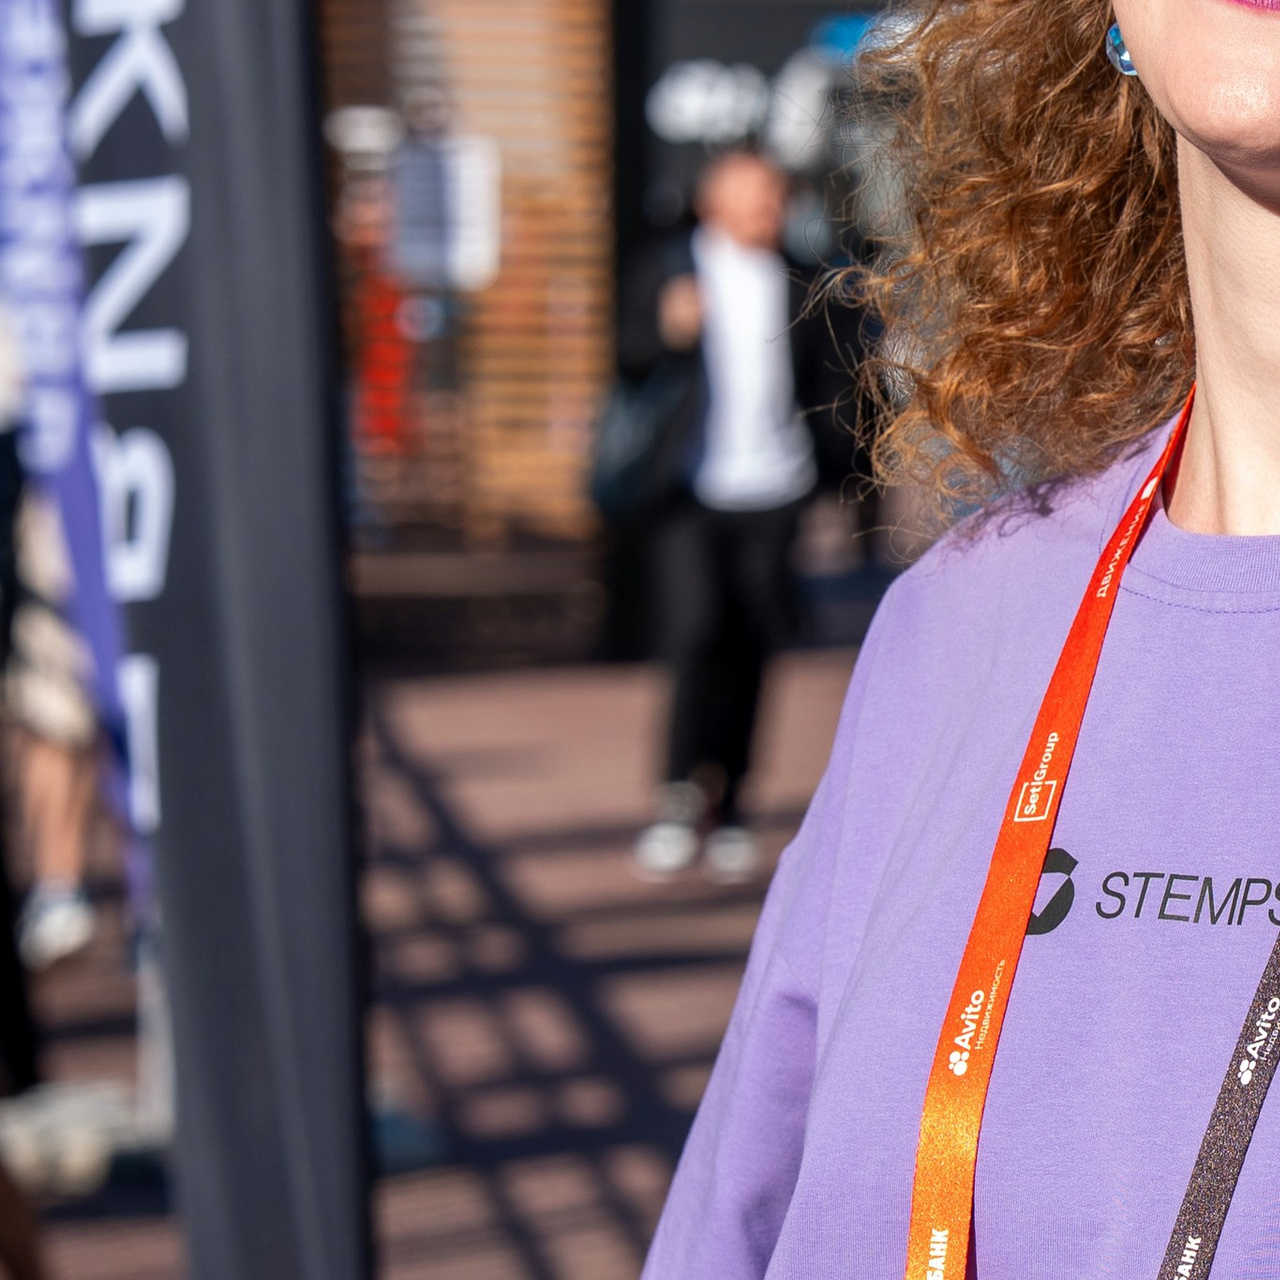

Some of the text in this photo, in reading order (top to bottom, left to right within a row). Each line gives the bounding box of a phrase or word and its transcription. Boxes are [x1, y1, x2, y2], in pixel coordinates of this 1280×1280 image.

[954, 989, 985, 1051] Avito
[974, 959, 1006, 1050] Недвижимость
[1247, 997, 1280, 1060] Avito
